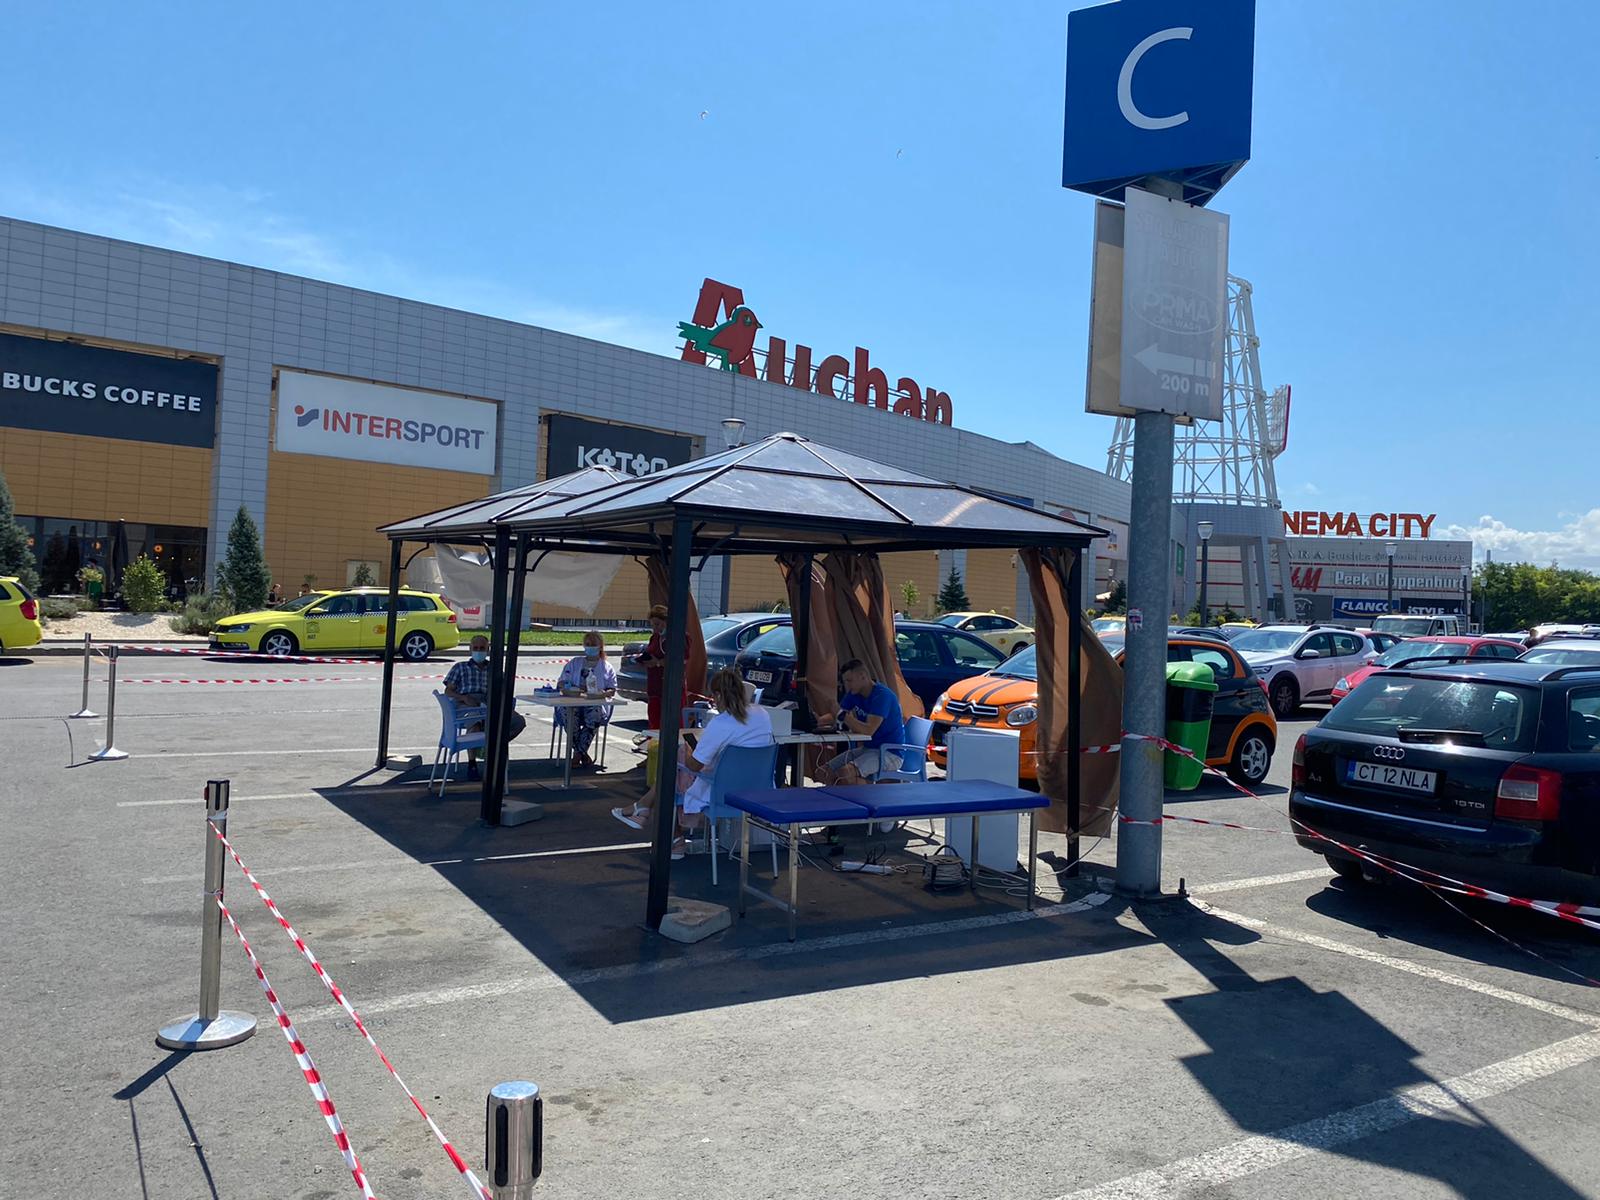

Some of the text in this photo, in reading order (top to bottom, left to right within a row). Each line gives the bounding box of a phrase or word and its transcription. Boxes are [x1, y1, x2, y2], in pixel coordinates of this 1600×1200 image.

[1117, 27, 1194, 131] C
[1143, 289, 1210, 325] PRIMA
[680, 277, 953, 427] Auchan
[3, 372, 201, 412] BUCKS COFFEE
[1161, 373, 1209, 396] 200 m
[323, 408, 485, 450] INTERSPORT
[1369, 513, 1437, 538] CITY
[1334, 571, 1370, 586] Peek
[1358, 764, 1430, 789] CT 12 NLA
